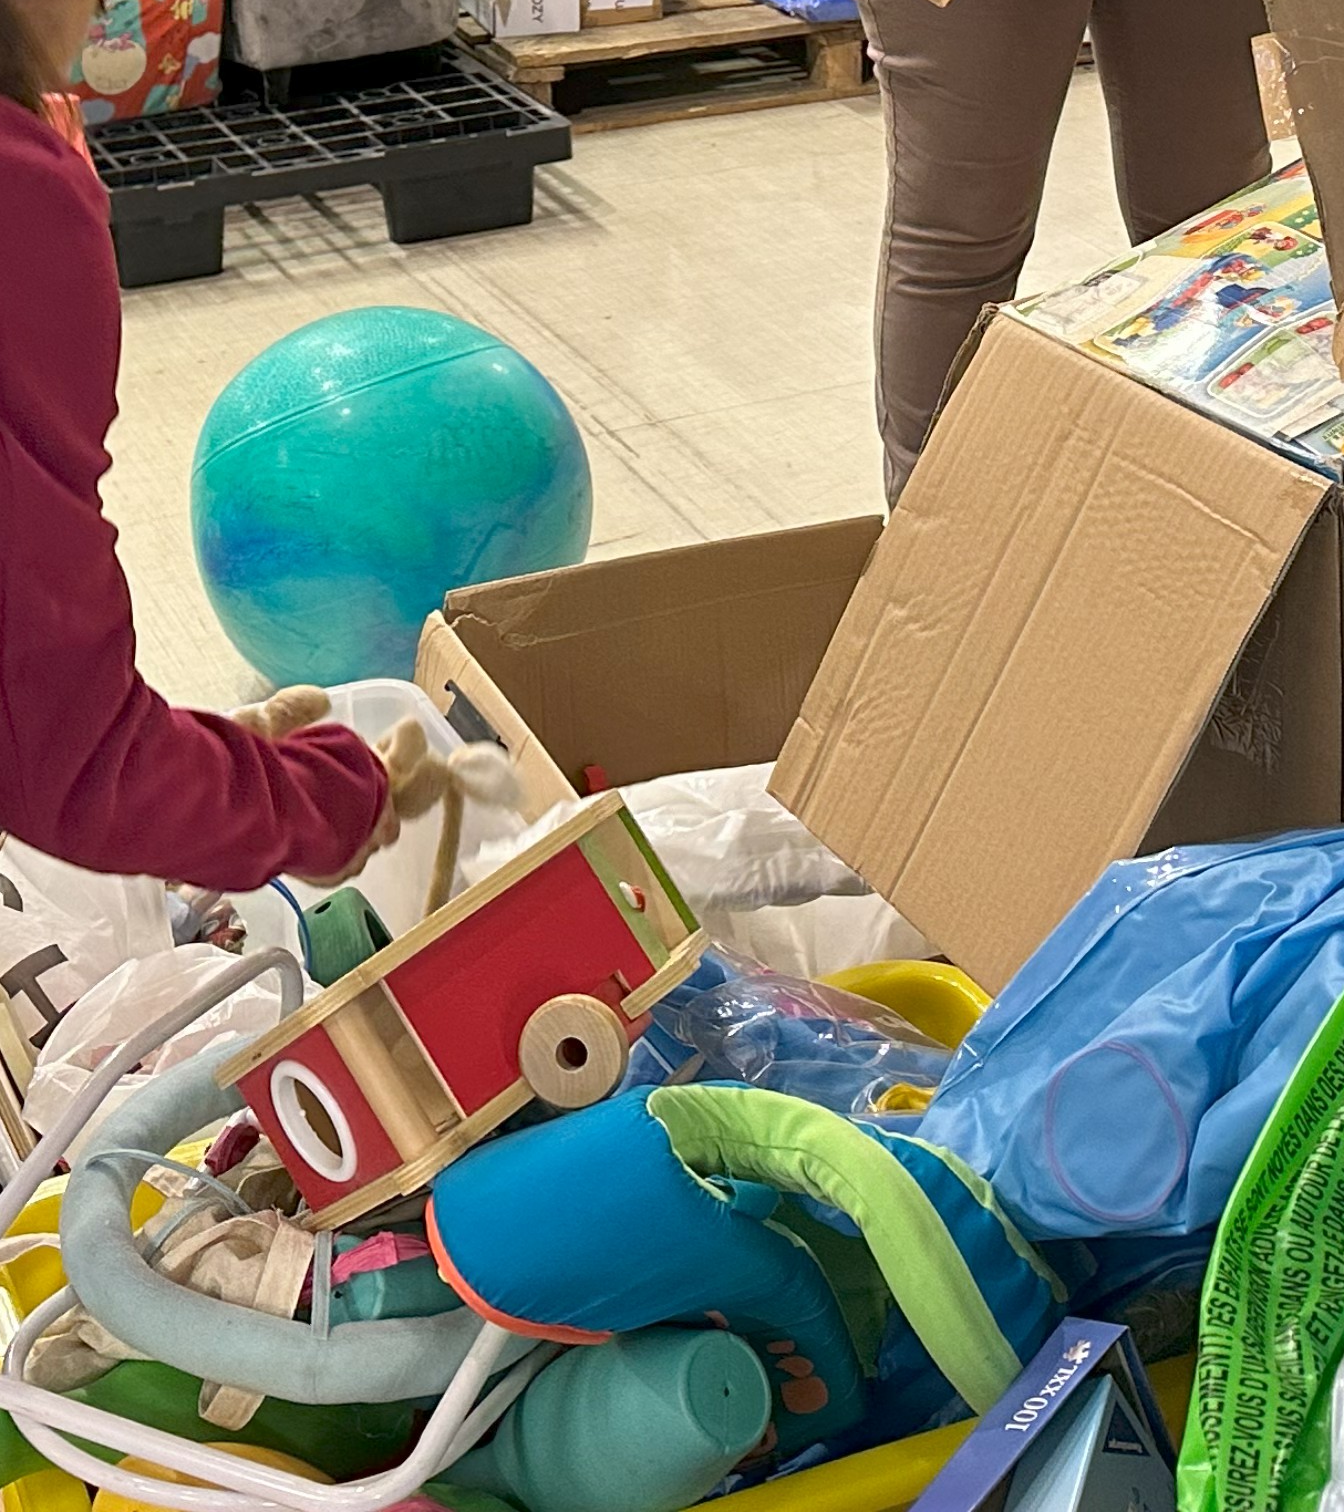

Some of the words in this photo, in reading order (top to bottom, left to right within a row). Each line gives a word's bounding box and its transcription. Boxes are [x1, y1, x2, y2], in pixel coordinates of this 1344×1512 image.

[1292, 1088, 1329, 1139] DANS
[1289, 1161, 1332, 1233] AUTOUR
[1285, 1233, 1316, 1264] OU
[1004, 1397, 1049, 1432] 100
[1039, 1364, 1078, 1397] XXL
[1225, 1397, 1268, 1511] SUREZ-VOUS
